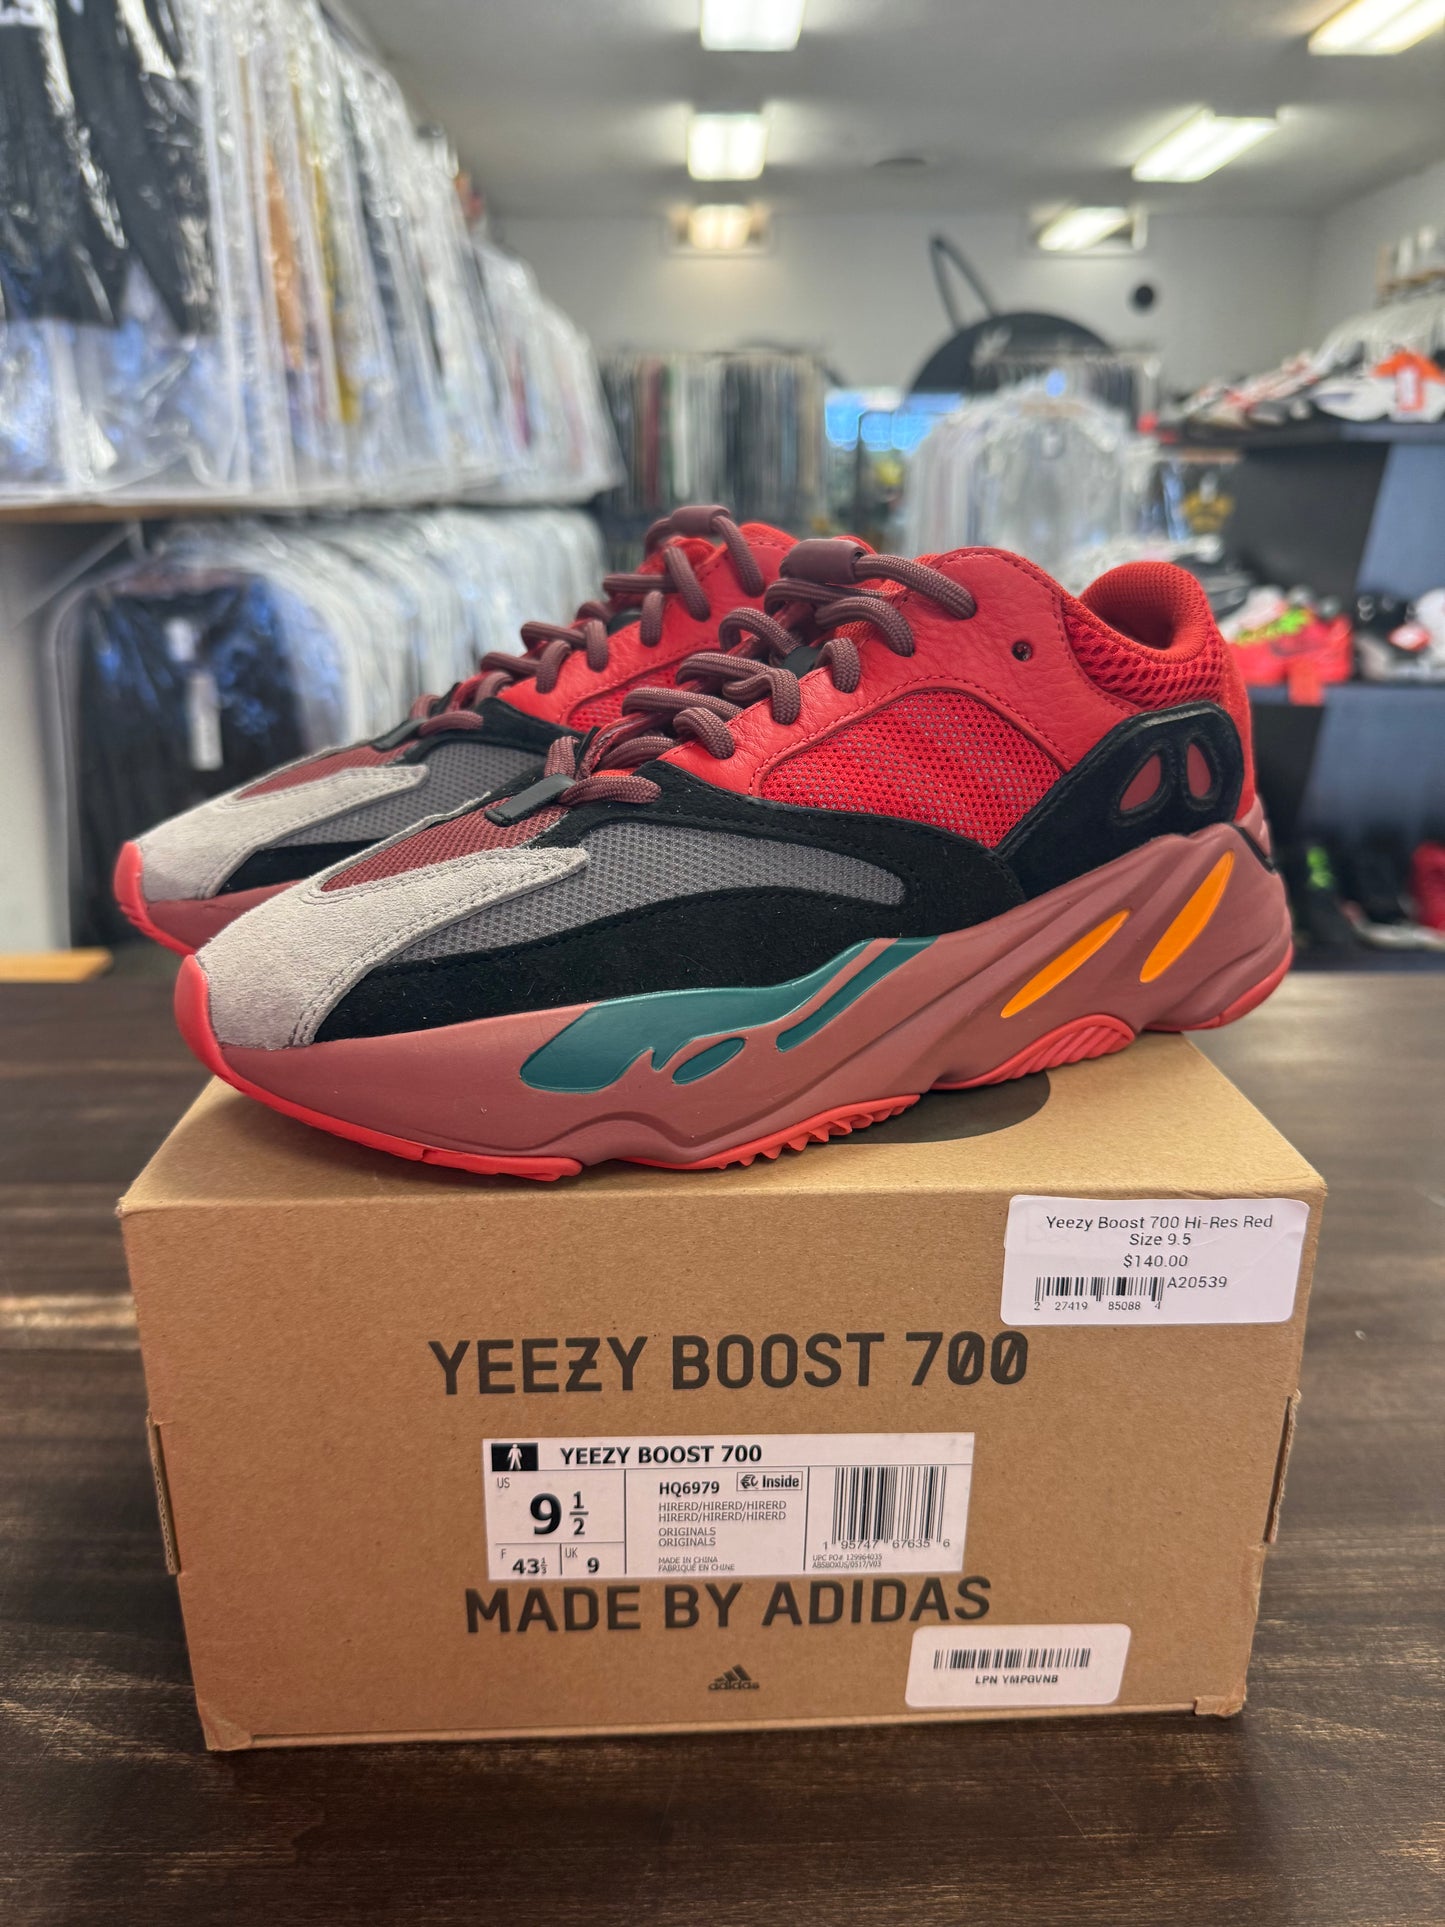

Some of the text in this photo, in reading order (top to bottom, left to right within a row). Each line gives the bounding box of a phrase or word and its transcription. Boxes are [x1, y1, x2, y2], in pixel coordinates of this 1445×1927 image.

[1046, 1214, 1273, 1231] Yeezy Boost 700 Hi-Res Red
[1129, 1233, 1191, 1246] Size 9.5
[1123, 1253, 1188, 1268] $140.00
[1166, 1276, 1227, 1289] A20539
[1034, 1301, 1161, 1311] 2 27419 85088 4
[428, 1330, 1029, 1394] YEEZY BOOST 700
[560, 1444, 762, 1465] YEEZY BOOST 700
[497, 1477, 511, 1488] US
[762, 1474, 800, 1488] Inside
[659, 1481, 720, 1497] HQ6979
[658, 1500, 787, 1512] HIRERD/HIRERD/HIRERD
[530, 1492, 562, 1535] 9
[658, 1511, 787, 1523] HIRERD/HIRERD/HIRERD
[658, 1527, 717, 1537] ORIGINALS
[658, 1537, 717, 1547] ORIGINALS
[841, 1540, 878, 1549] 95747
[892, 1539, 930, 1548] 67635
[943, 1539, 950, 1547] 6
[565, 1548, 578, 1558] UK
[587, 1557, 600, 1573] 9
[658, 1556, 718, 1564] MADE IN CHINA
[699, 1563, 709, 1571] EN
[711, 1563, 735, 1571] CHINE
[464, 1575, 991, 1633] MADE BY ADIDAS
[708, 1679, 760, 1690] adidas
[975, 1675, 998, 1684] LPN
